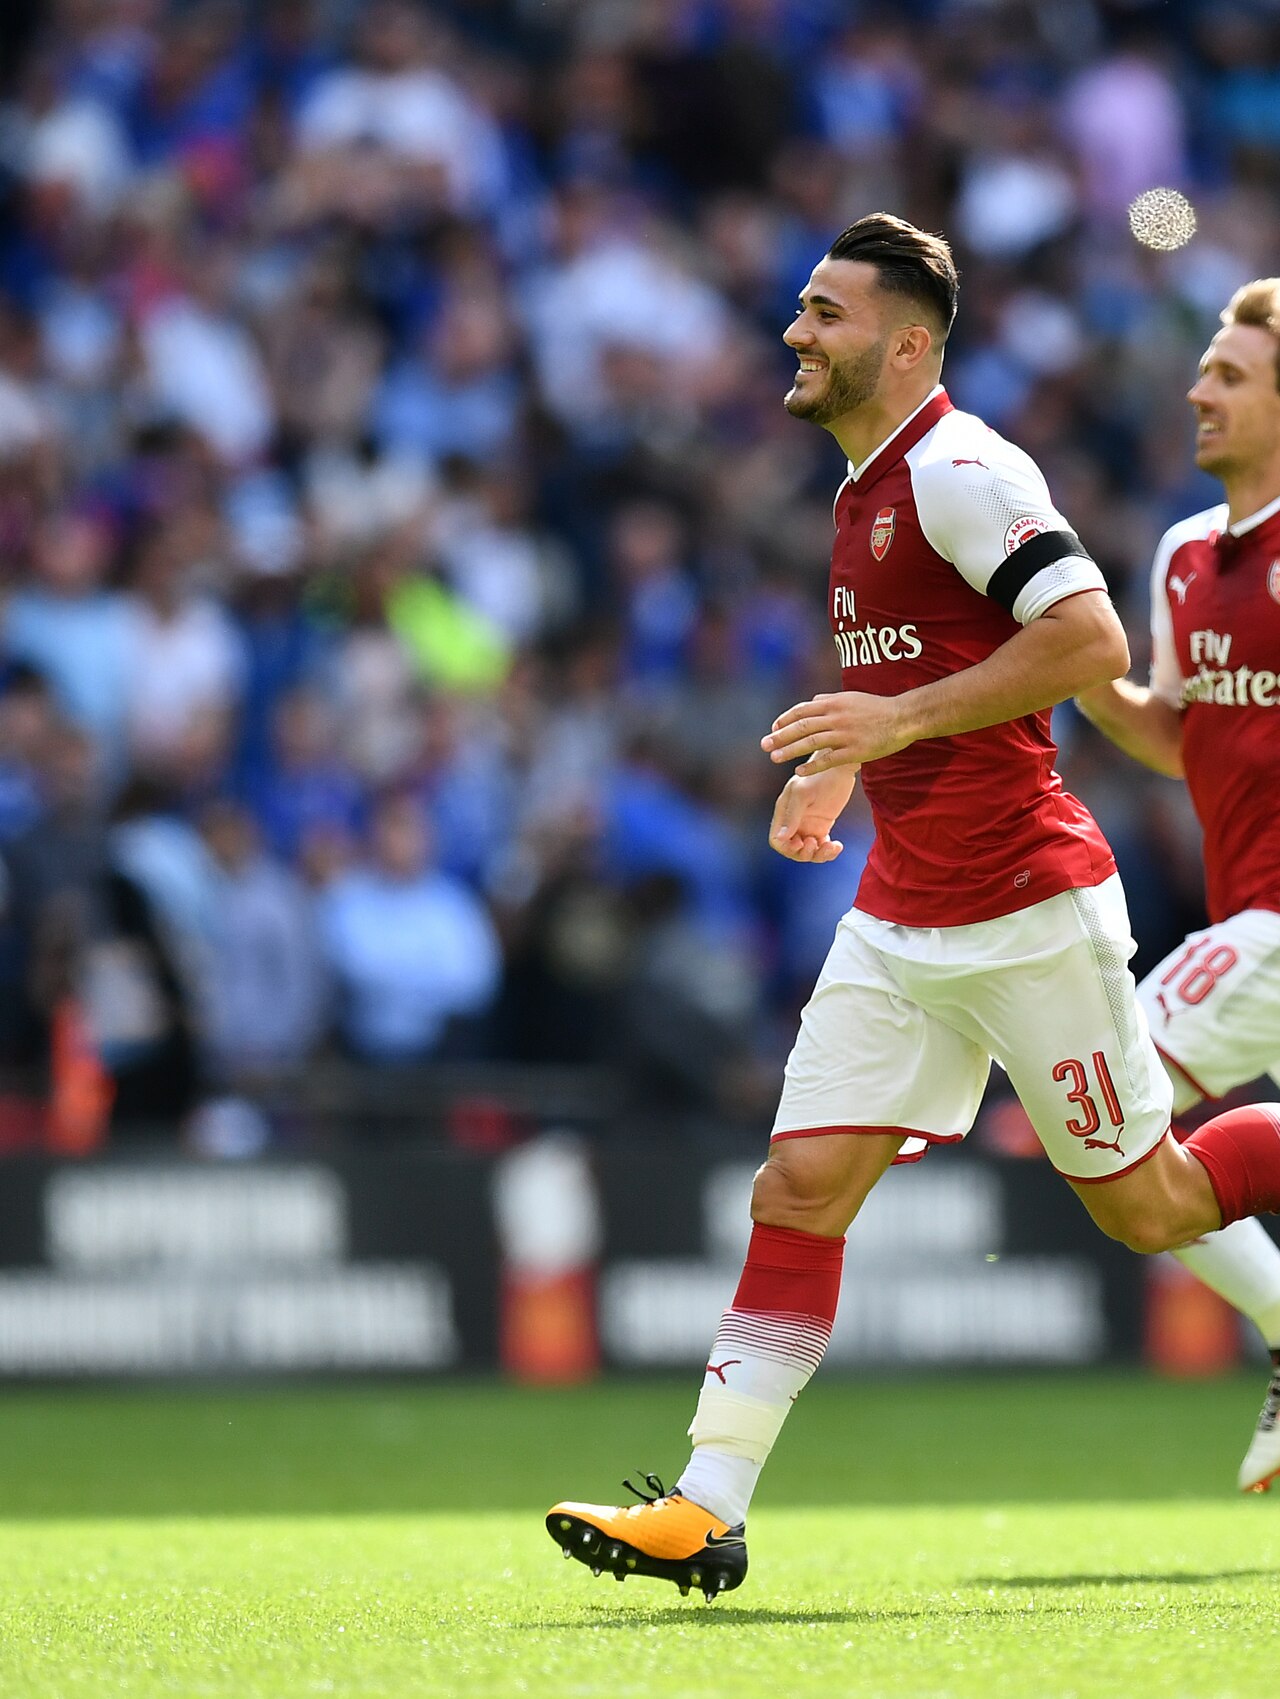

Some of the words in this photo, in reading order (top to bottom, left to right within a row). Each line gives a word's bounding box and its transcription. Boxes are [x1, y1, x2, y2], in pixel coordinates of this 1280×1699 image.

[834, 586, 856, 622] Fly
[834, 621, 923, 668] irates
[1190, 628, 1232, 667] Fly
[1161, 936, 1237, 1006] 18
[1052, 1051, 1125, 1137] 31
